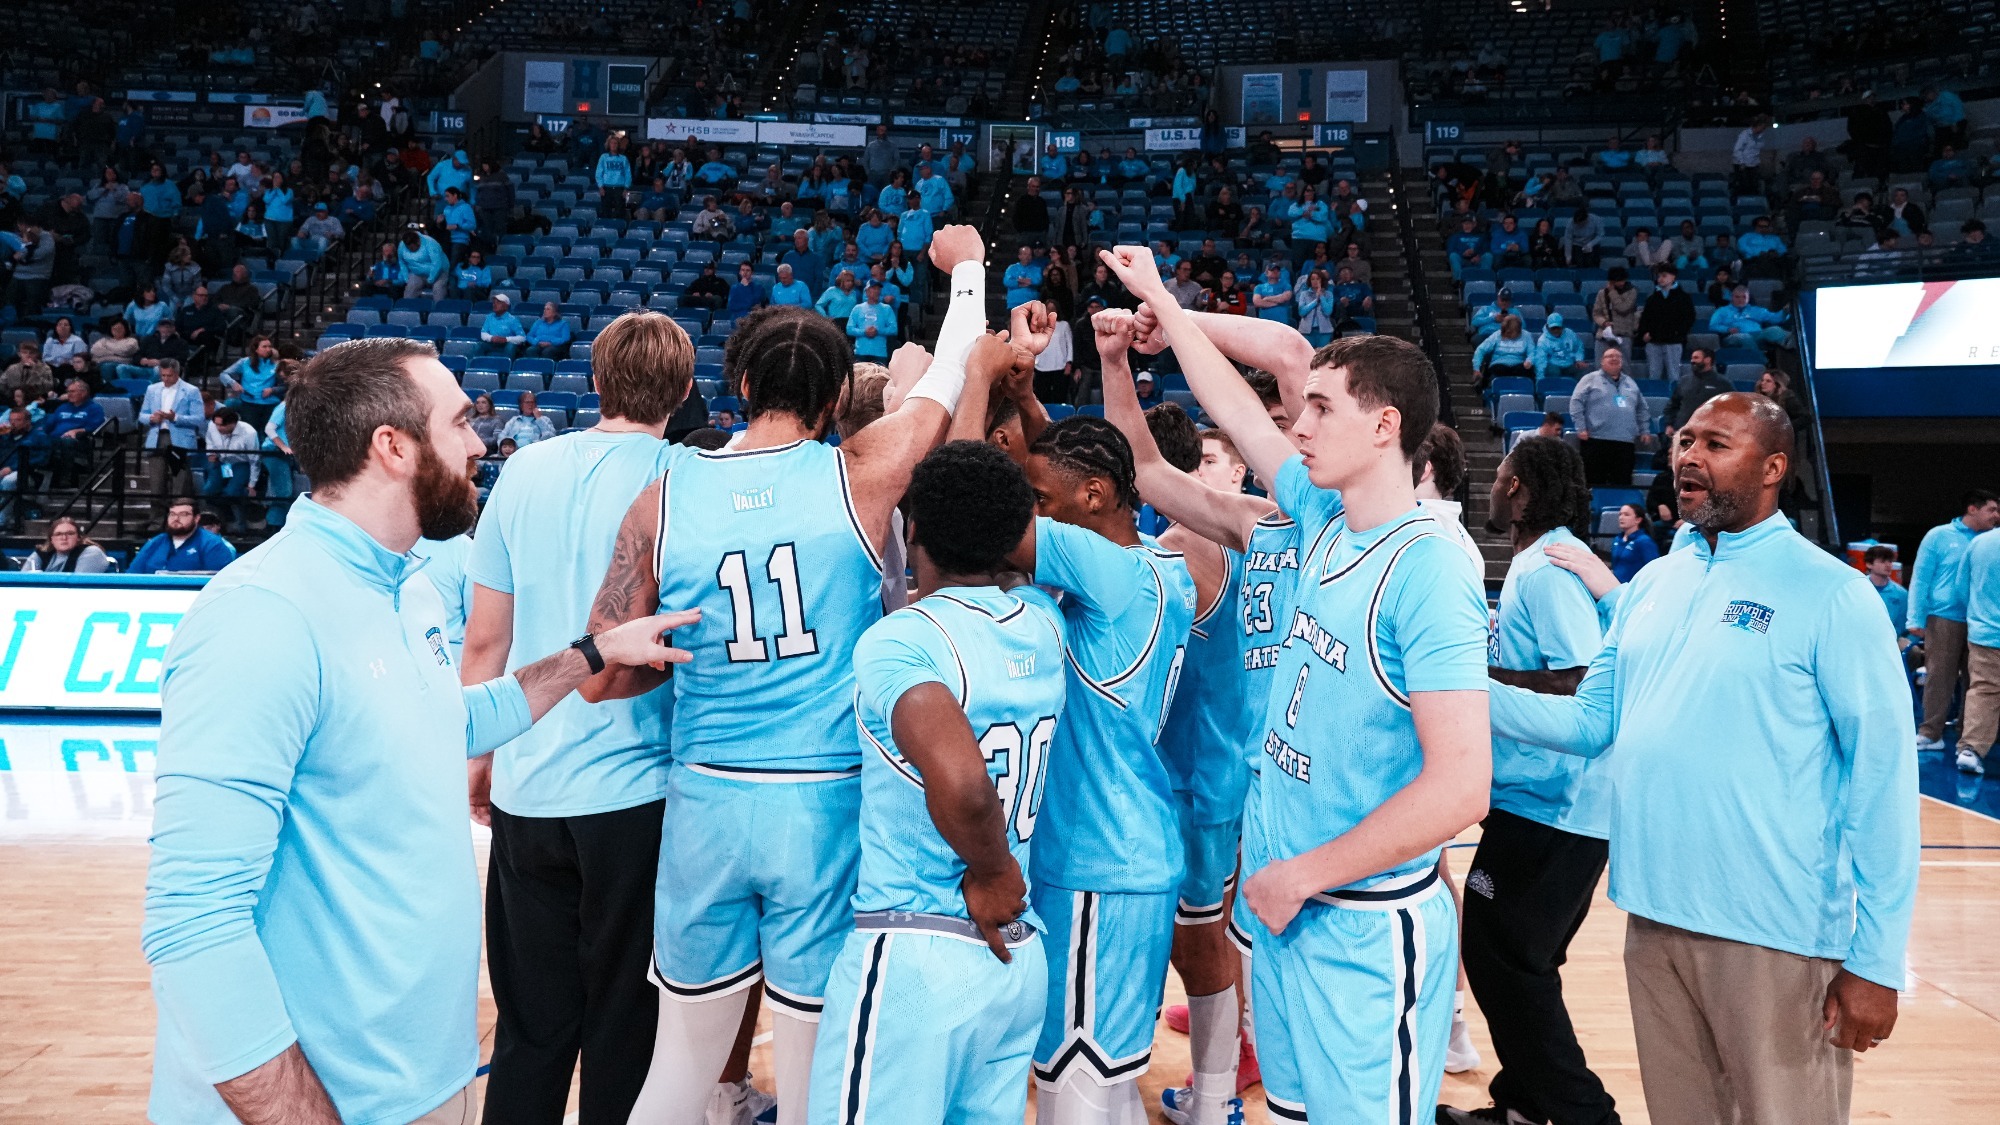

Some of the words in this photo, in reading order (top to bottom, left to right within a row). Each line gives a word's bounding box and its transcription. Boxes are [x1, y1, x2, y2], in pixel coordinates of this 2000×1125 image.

[442, 116, 464, 128] 116
[547, 120, 568, 132] 117
[681, 126, 710, 134] THSB
[1161, 130, 1185, 140] U.S.
[1326, 129, 1348, 141] 118
[1436, 126, 1458, 138] 119
[952, 134, 972, 145] 117
[1055, 136, 1075, 148] 118
[731, 485, 774, 511] VALLEY
[716, 541, 819, 663] 11
[1243, 581, 1274, 636] 23
[1725, 604, 1772, 624] RUMBLE
[1244, 644, 1280, 671] STATE
[1004, 651, 1037, 679] VALLEY
[1265, 728, 1311, 785] STATE
